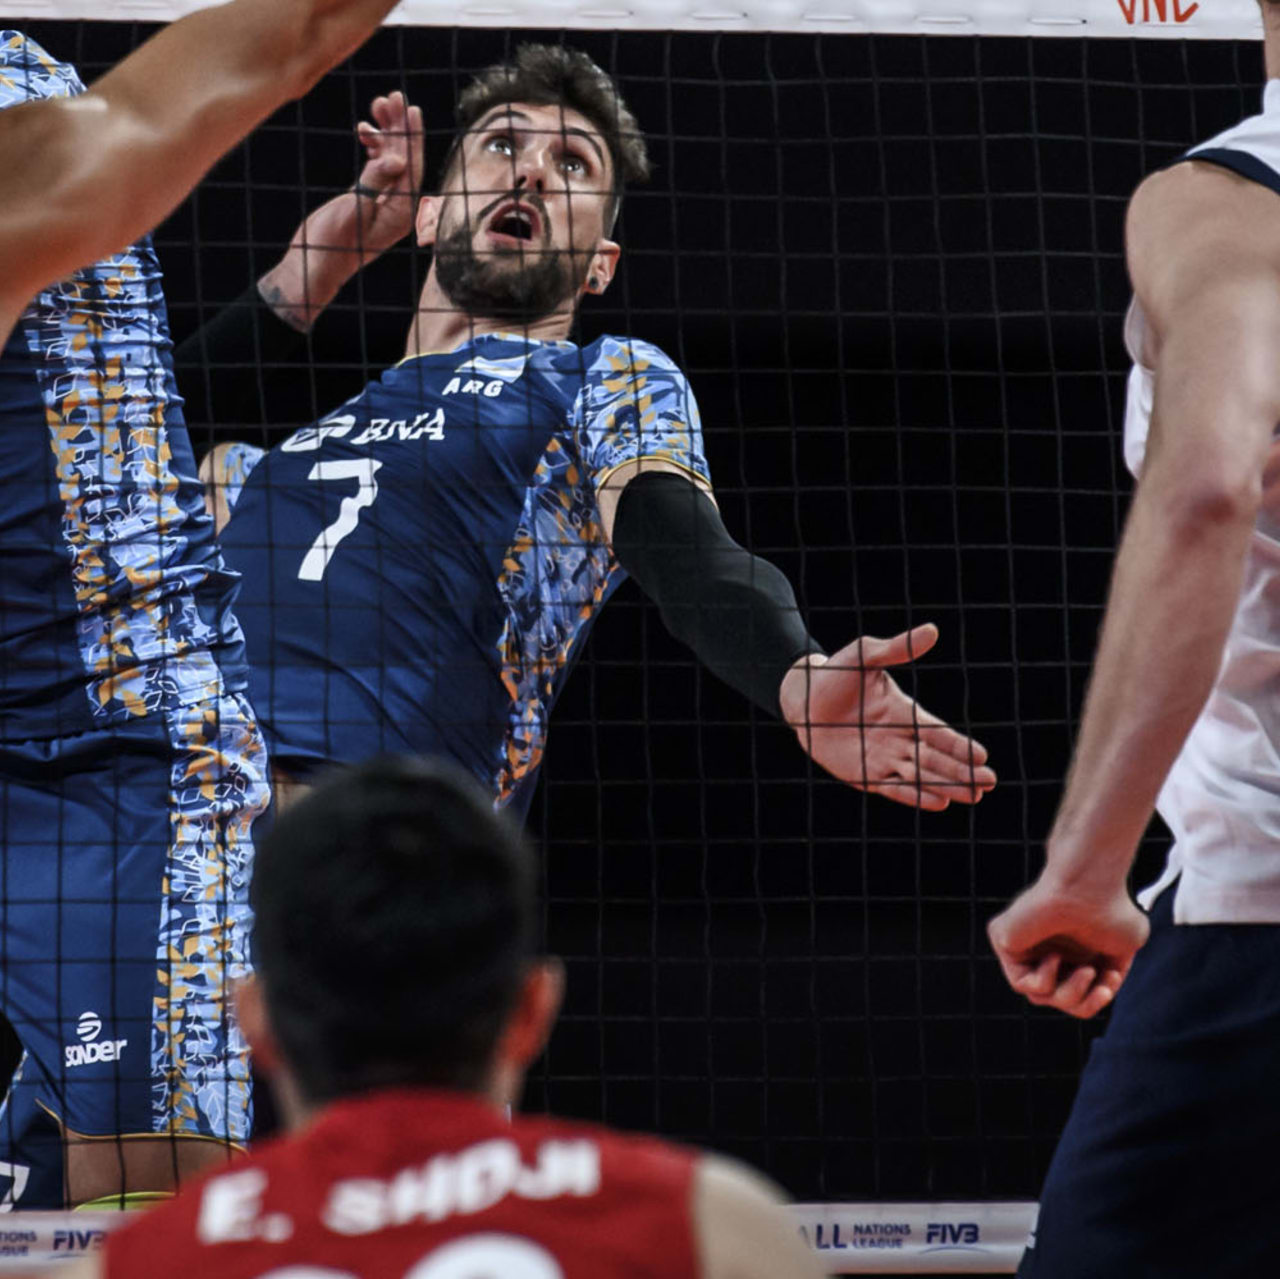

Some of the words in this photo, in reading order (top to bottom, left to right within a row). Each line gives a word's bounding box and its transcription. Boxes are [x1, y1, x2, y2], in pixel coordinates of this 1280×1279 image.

[441, 377, 505, 397] ARG
[350, 407, 446, 445] BNA
[297, 457, 384, 582] 7
[198, 1166, 294, 1245] E.
[322, 1137, 602, 1236] SHOJI
[853, 1223, 911, 1237] NATIONS
[926, 1223, 980, 1244] FIVB
[852, 1238, 904, 1250] LEAGUE
